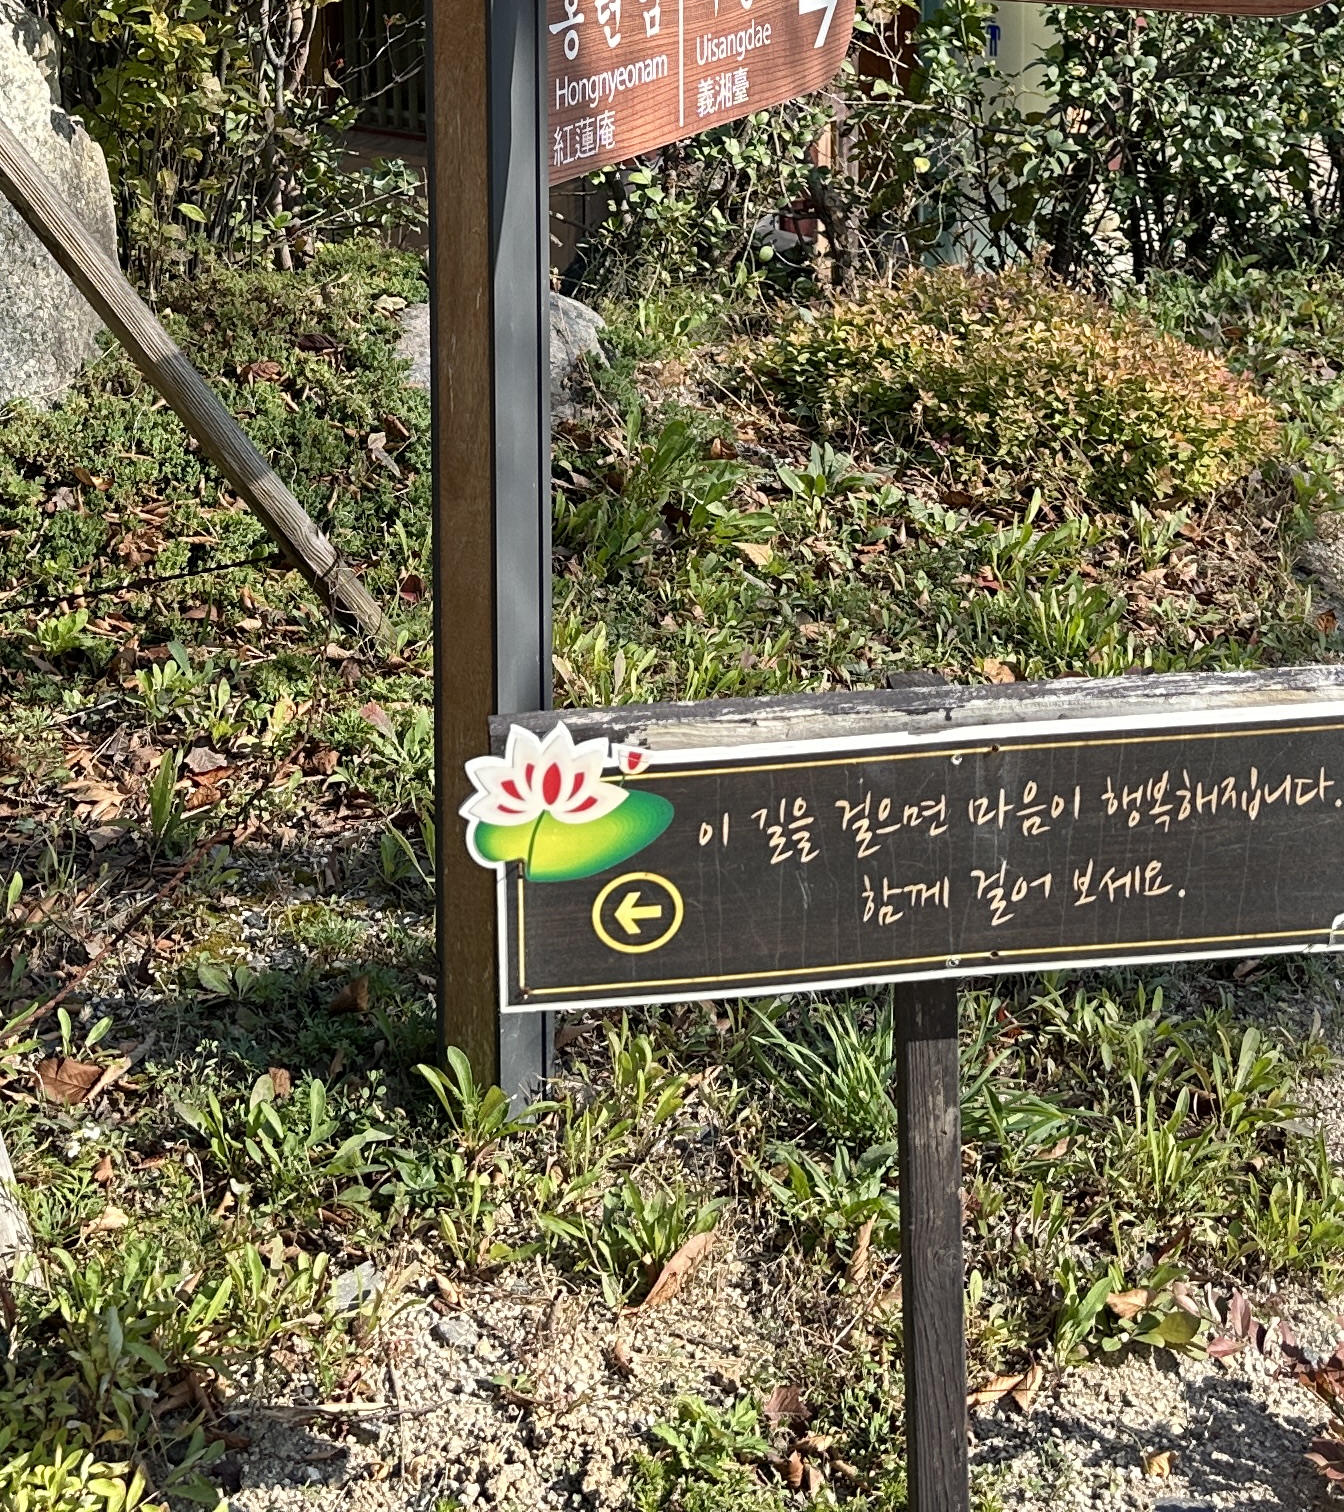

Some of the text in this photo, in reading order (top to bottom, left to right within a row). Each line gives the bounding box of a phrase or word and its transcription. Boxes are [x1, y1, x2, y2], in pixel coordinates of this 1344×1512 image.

[696, 18, 772, 65] Uisangdae
[556, 54, 668, 110] Hongnyeonam
[699, 766, 1343, 865] 이 길을 걸으면 마음이 행복해집니다.
[861, 857, 1186, 926] 함께 걸어 보세요.
